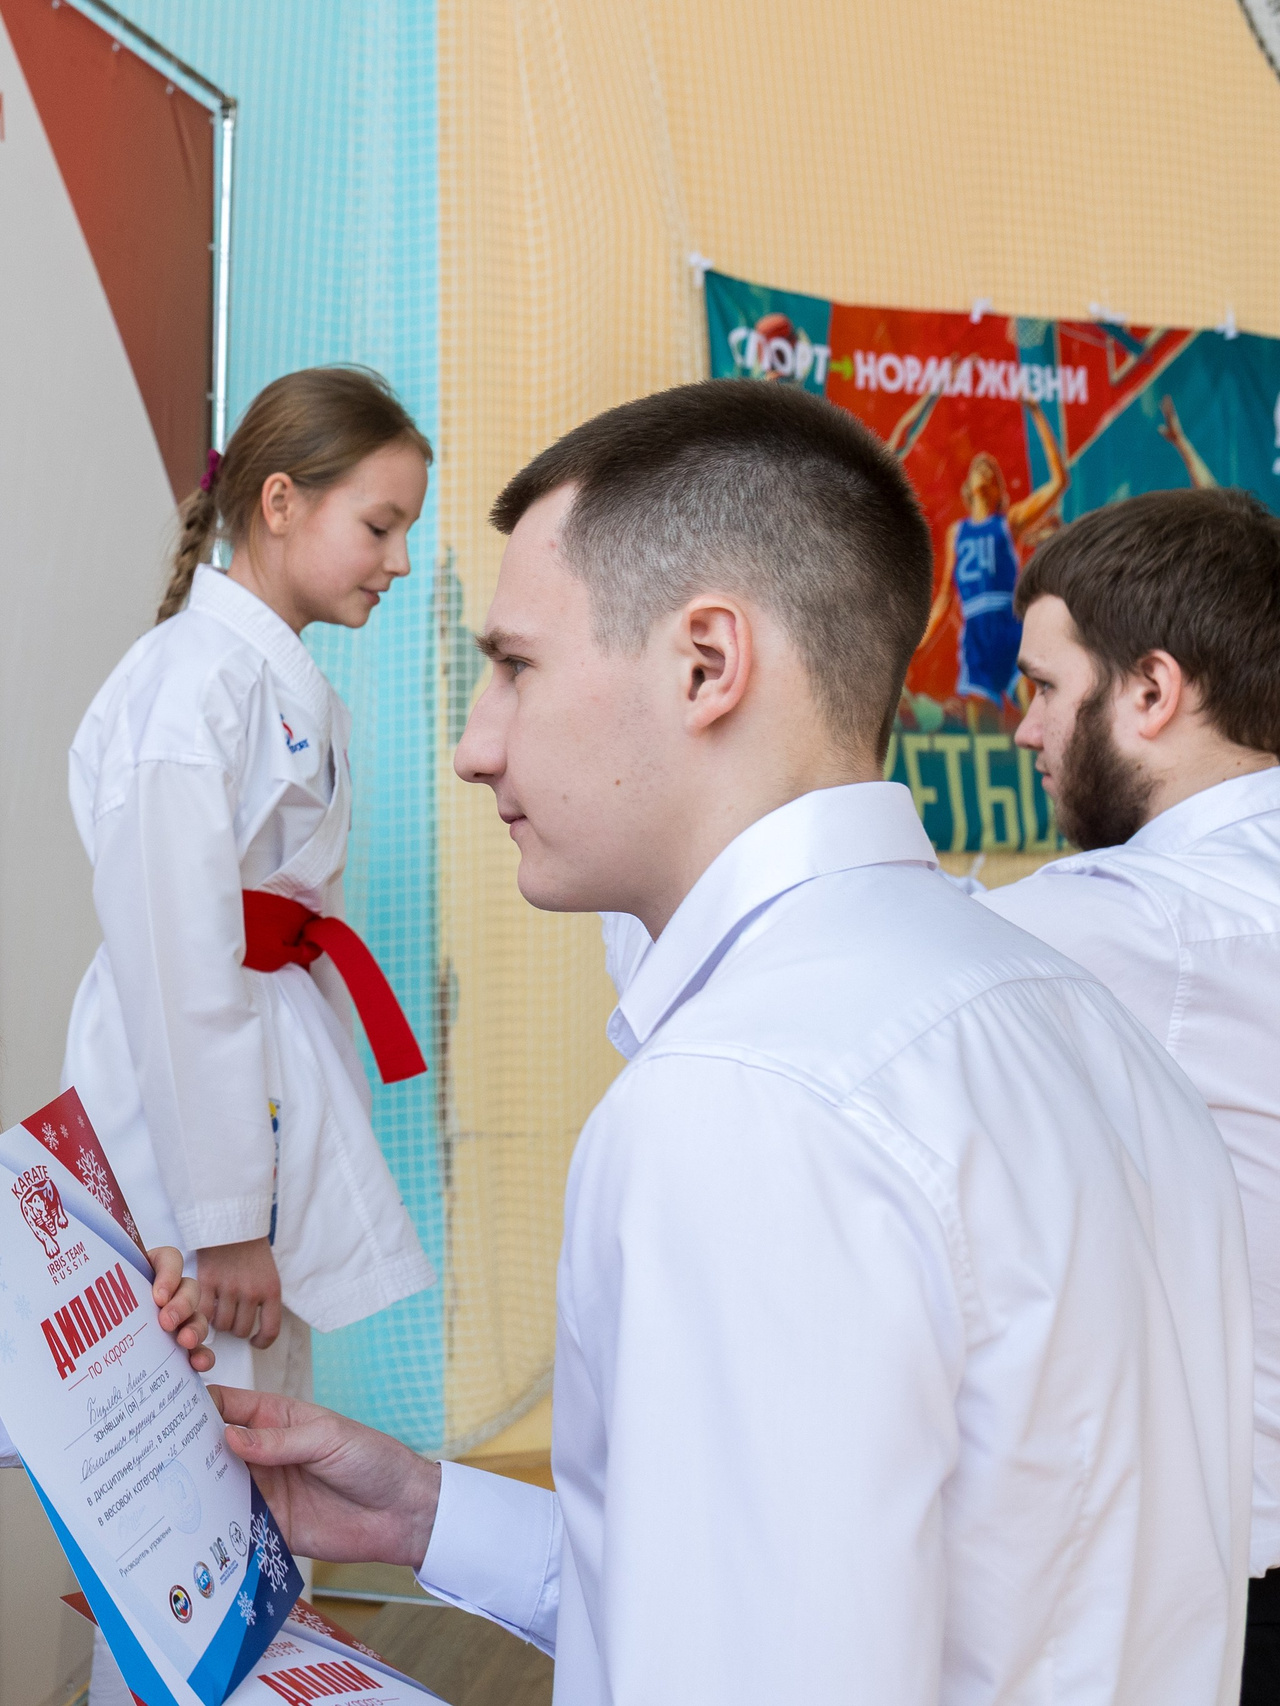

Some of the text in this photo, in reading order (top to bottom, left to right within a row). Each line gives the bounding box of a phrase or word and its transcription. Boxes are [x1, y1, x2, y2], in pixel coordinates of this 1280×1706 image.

[729, 327, 1089, 405] СПОРТ НОРМА ЖИЗНИ
[958, 535, 996, 582] 24
[11, 1165, 50, 1200] KARATE
[47, 1241, 86, 1276] IRBIS TEAM
[52, 1253, 90, 1285] RUSSIA
[40, 1262, 139, 1380] ДИПЛОМ
[87, 1334, 134, 1379] по каратэ
[94, 1409, 126, 1443] занявший
[126, 1395, 140, 1418] (ая)
[150, 1375, 166, 1394] место
[93, 1462, 134, 1503] дисциплине
[162, 1412, 185, 1440] возрасте
[104, 1489, 133, 1521] весовой
[133, 1461, 165, 1494] категории
[257, 1661, 384, 1706] ДИПЛОМ
